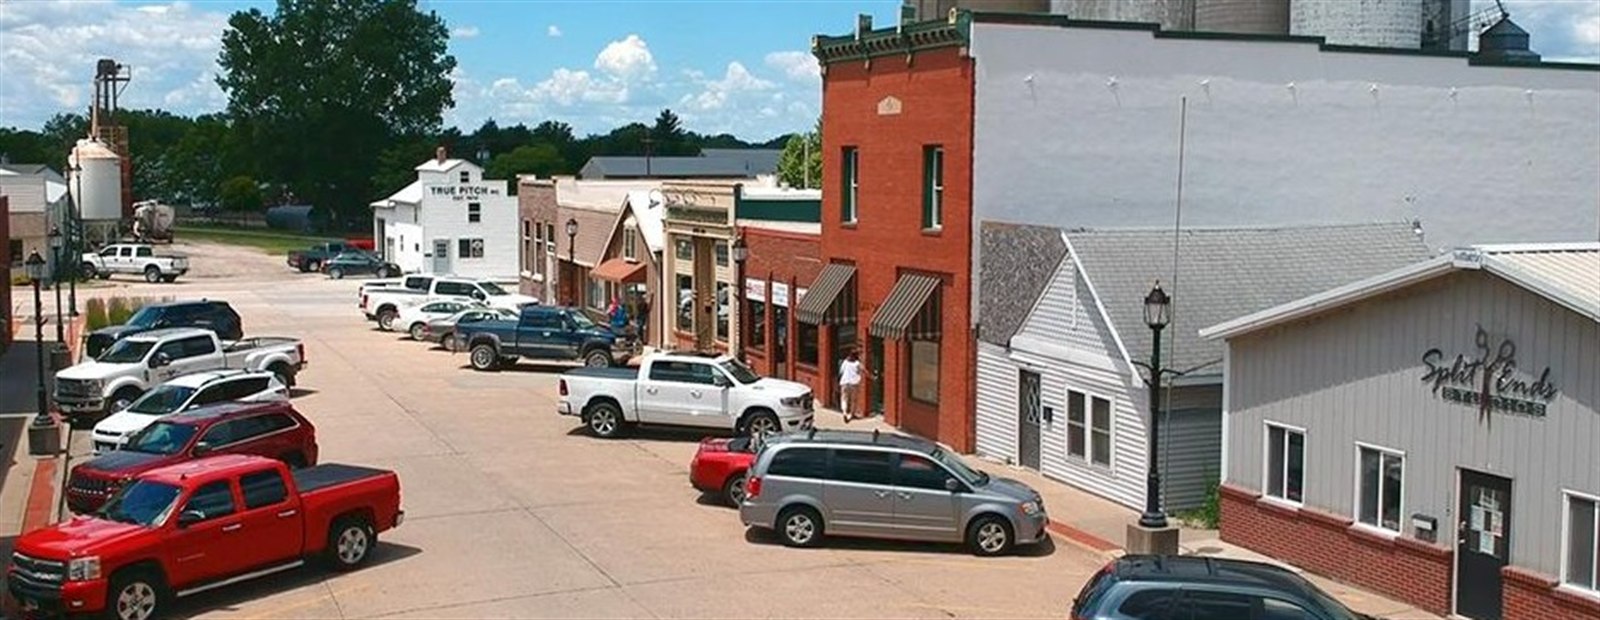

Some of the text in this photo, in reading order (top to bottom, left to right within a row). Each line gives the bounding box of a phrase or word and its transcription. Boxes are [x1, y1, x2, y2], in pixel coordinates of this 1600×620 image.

[431, 186, 456, 195] TRUE
[459, 186, 488, 195] PITCH
[1421, 348, 1557, 399] Split Ends
